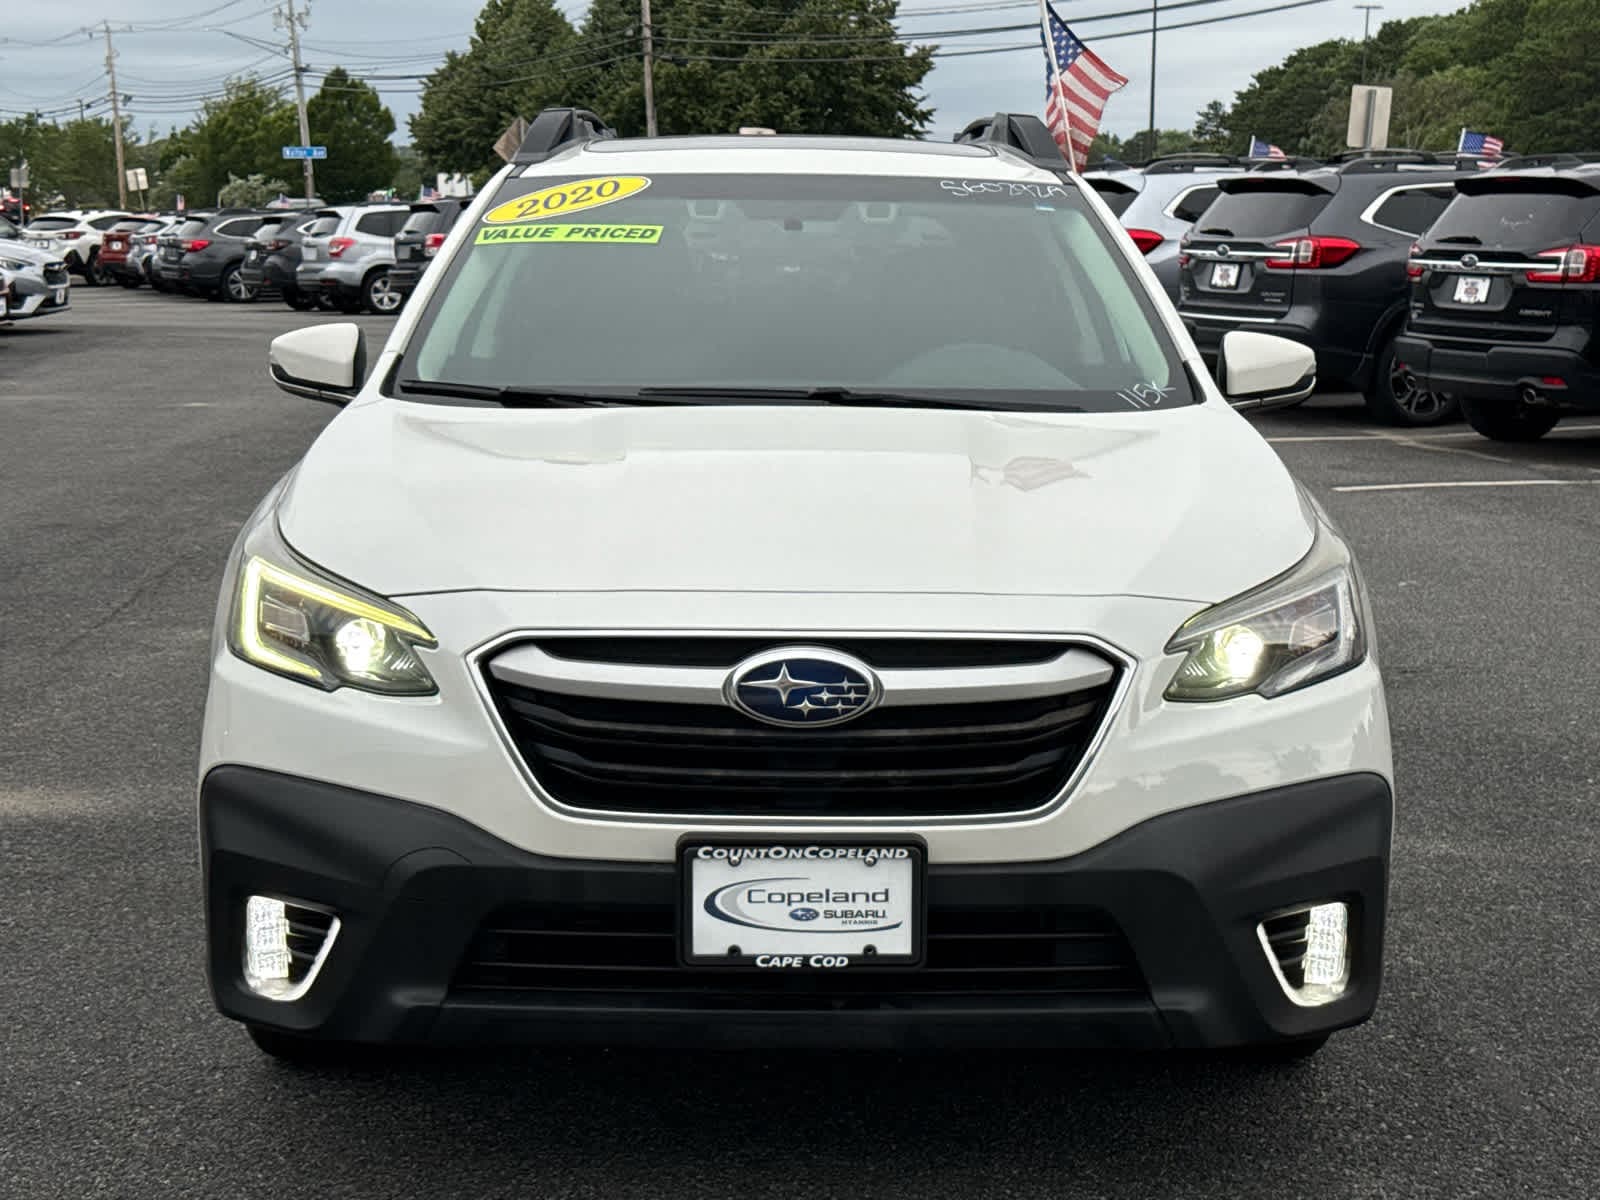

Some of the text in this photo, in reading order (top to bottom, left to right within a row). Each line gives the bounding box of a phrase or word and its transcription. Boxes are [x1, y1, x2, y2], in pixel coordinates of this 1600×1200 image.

[516, 180, 620, 218] 2020
[481, 227, 657, 241] VALUE PRICED
[747, 888, 889, 907] Copeland
[823, 909, 887, 919] SUBARU
[757, 954, 849, 968] CAPE COD
